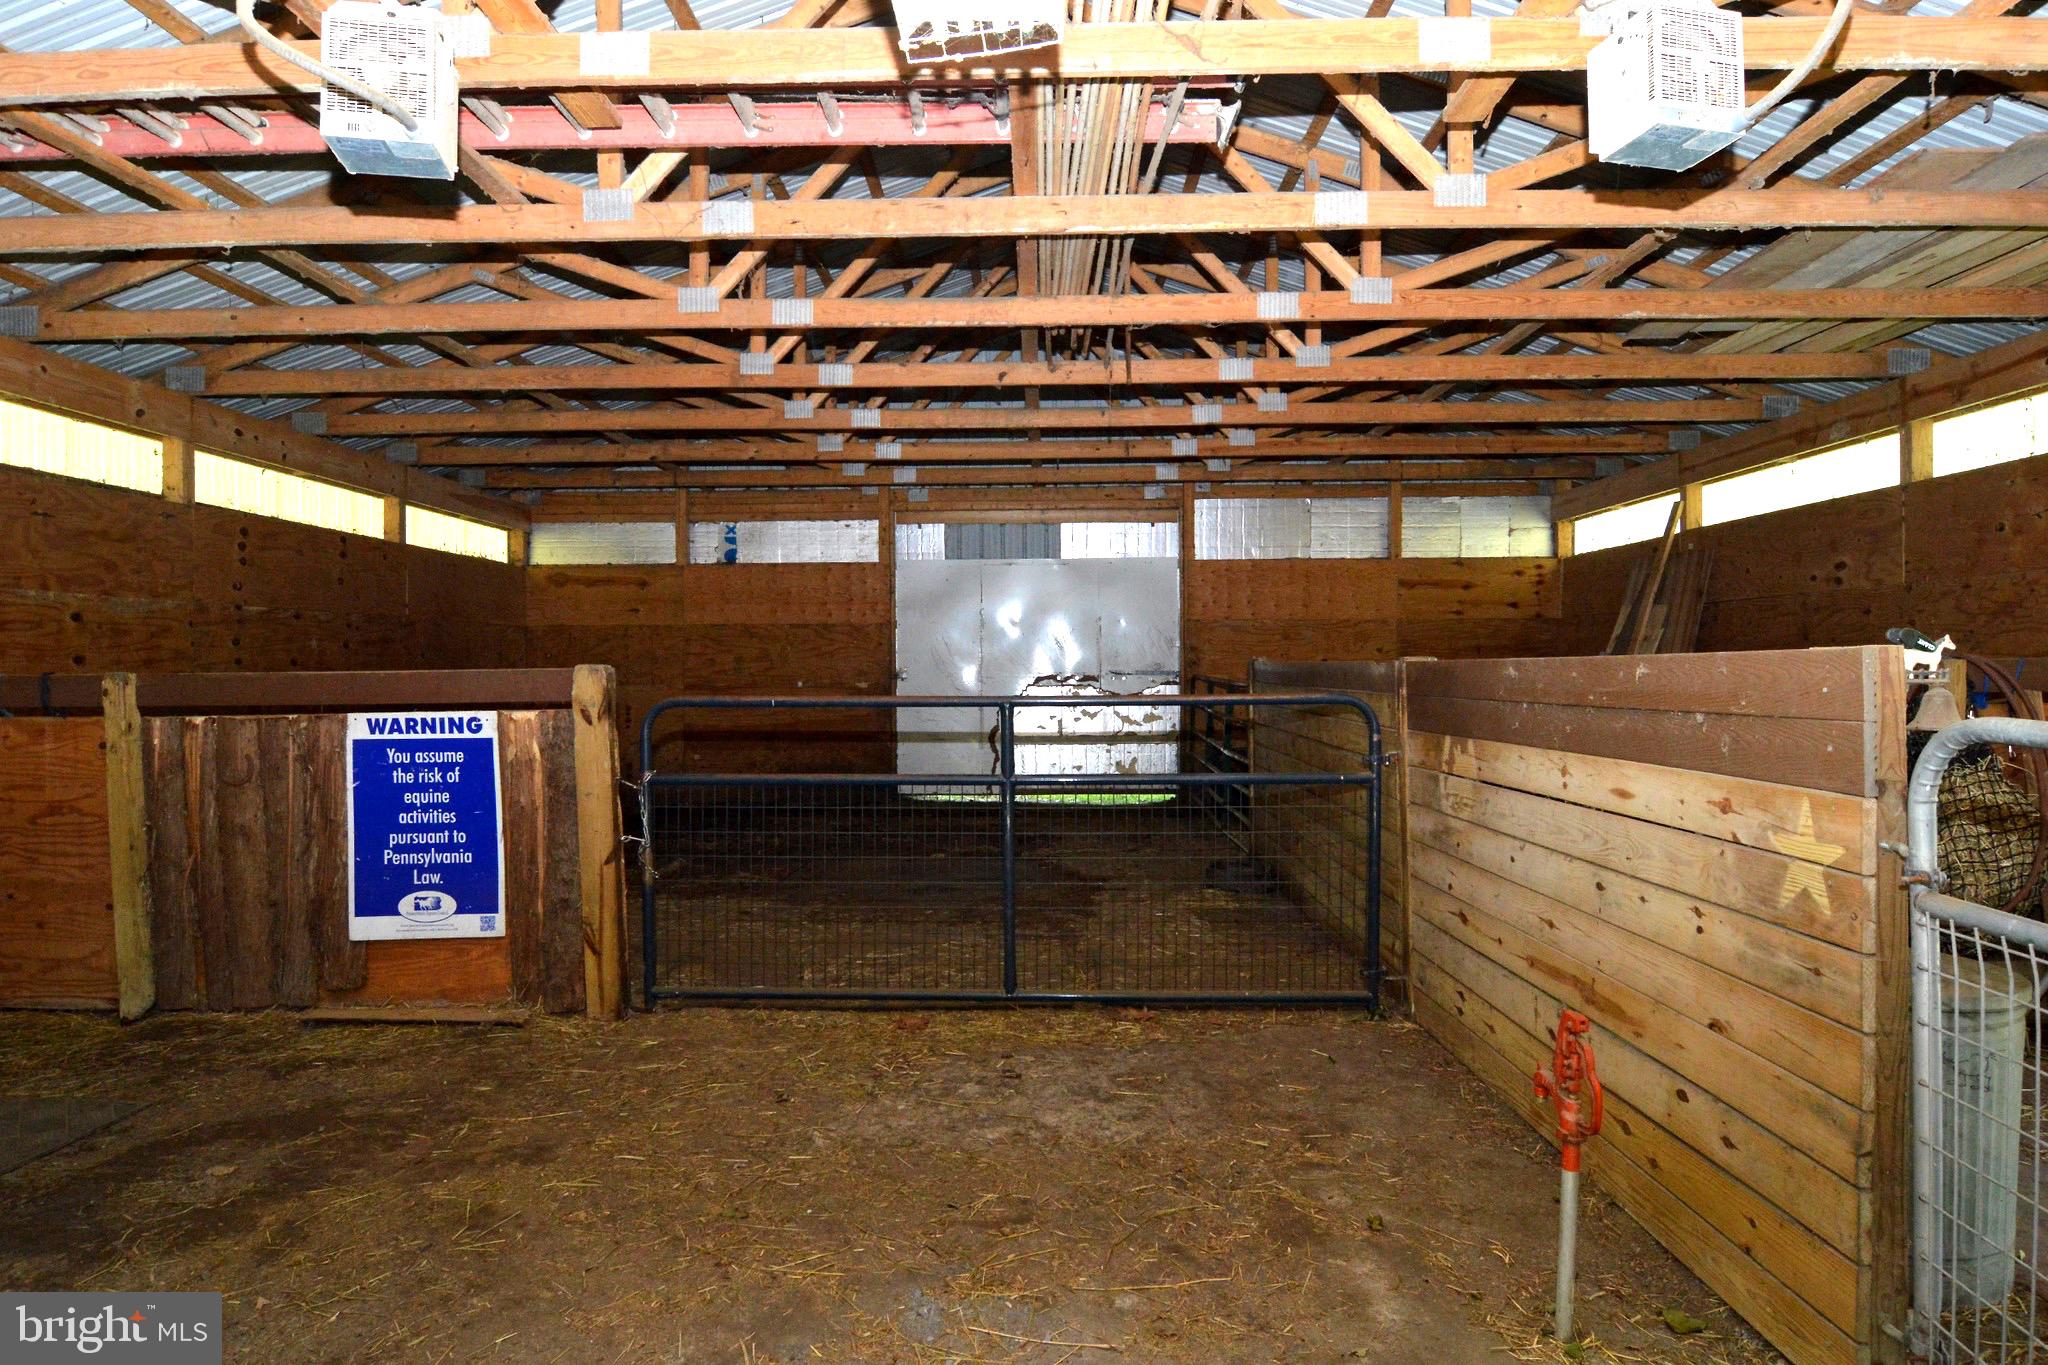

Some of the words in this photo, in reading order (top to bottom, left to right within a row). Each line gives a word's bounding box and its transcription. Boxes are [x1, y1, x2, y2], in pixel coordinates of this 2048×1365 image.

[366, 716, 483, 736] WARNING
[386, 748, 410, 764] You
[415, 750, 465, 764] assume
[392, 769, 415, 784] the
[418, 768, 442, 783] risk
[446, 767, 460, 783] of
[403, 789, 450, 807] equine
[398, 809, 457, 825] activities
[389, 830, 449, 848] pursuant
[452, 829, 466, 844] to
[383, 848, 473, 867] Pennsylvania
[413, 869, 444, 885] Law.
